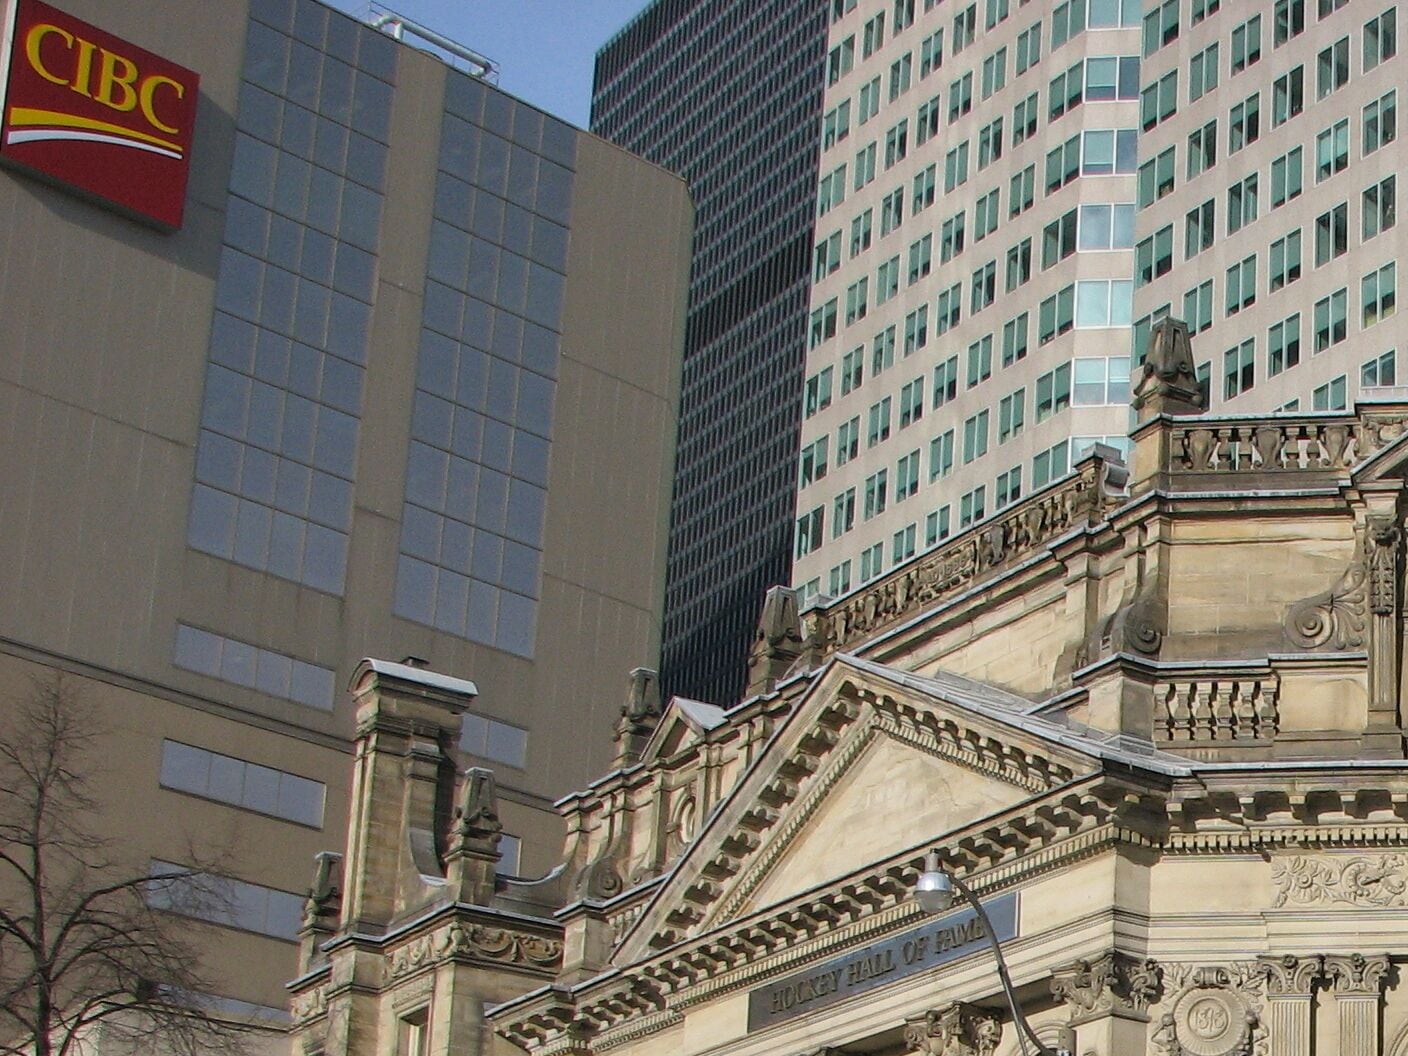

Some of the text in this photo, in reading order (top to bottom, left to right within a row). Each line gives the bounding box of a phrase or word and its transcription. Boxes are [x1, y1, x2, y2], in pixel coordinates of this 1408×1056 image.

[26, 24, 184, 134] CIBC
[769, 917, 986, 1013] HOCKEY HALL OF FAME
